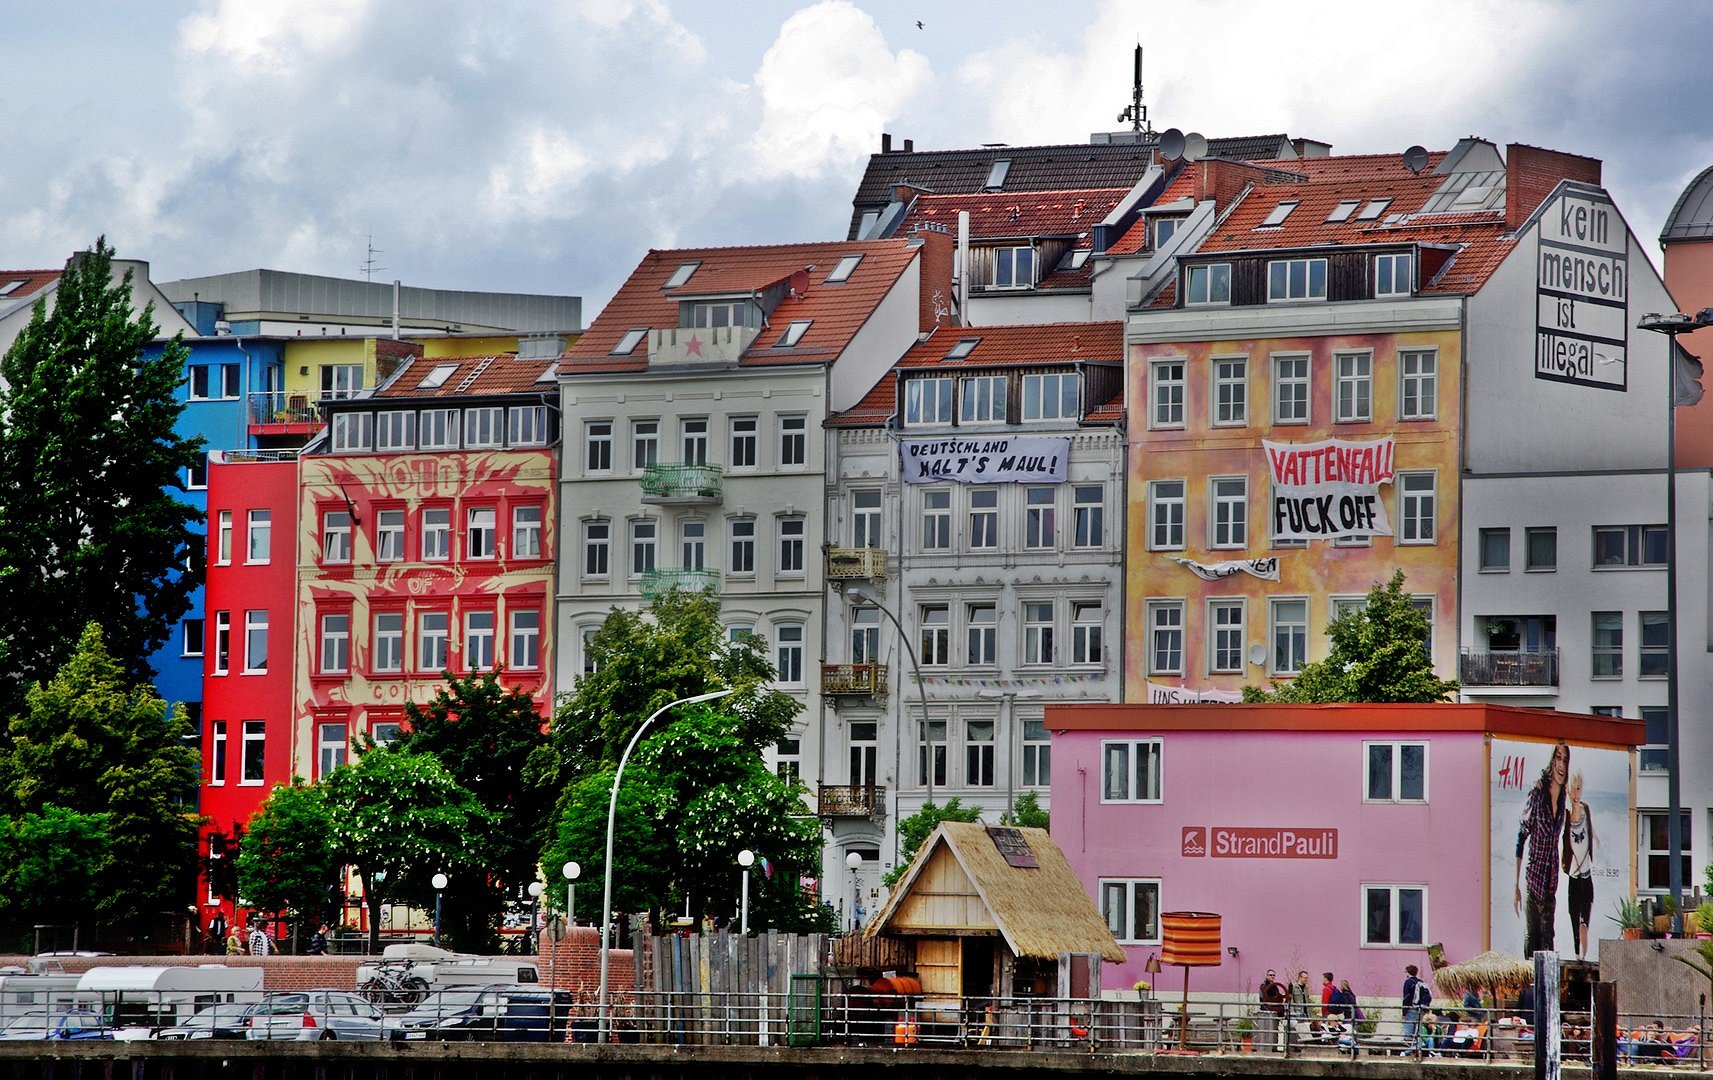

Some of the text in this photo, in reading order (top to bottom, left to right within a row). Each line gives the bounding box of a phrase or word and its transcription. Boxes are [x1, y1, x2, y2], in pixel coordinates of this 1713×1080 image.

[1561, 197, 1608, 244] kein
[1542, 252, 1622, 298] mensch
[1557, 298, 1575, 328] ist
[1542, 334, 1594, 377] illegal
[911, 440, 1008, 457] DEUTSCHLAND
[919, 456, 1058, 477] HALT'S MAUL!
[1269, 440, 1395, 486] VATTENFALL
[1276, 494, 1376, 534] FUCK OFF
[407, 577, 433, 594] OF
[1498, 755, 1525, 791] H&M
[1216, 831, 1334, 856] StrandPauli
